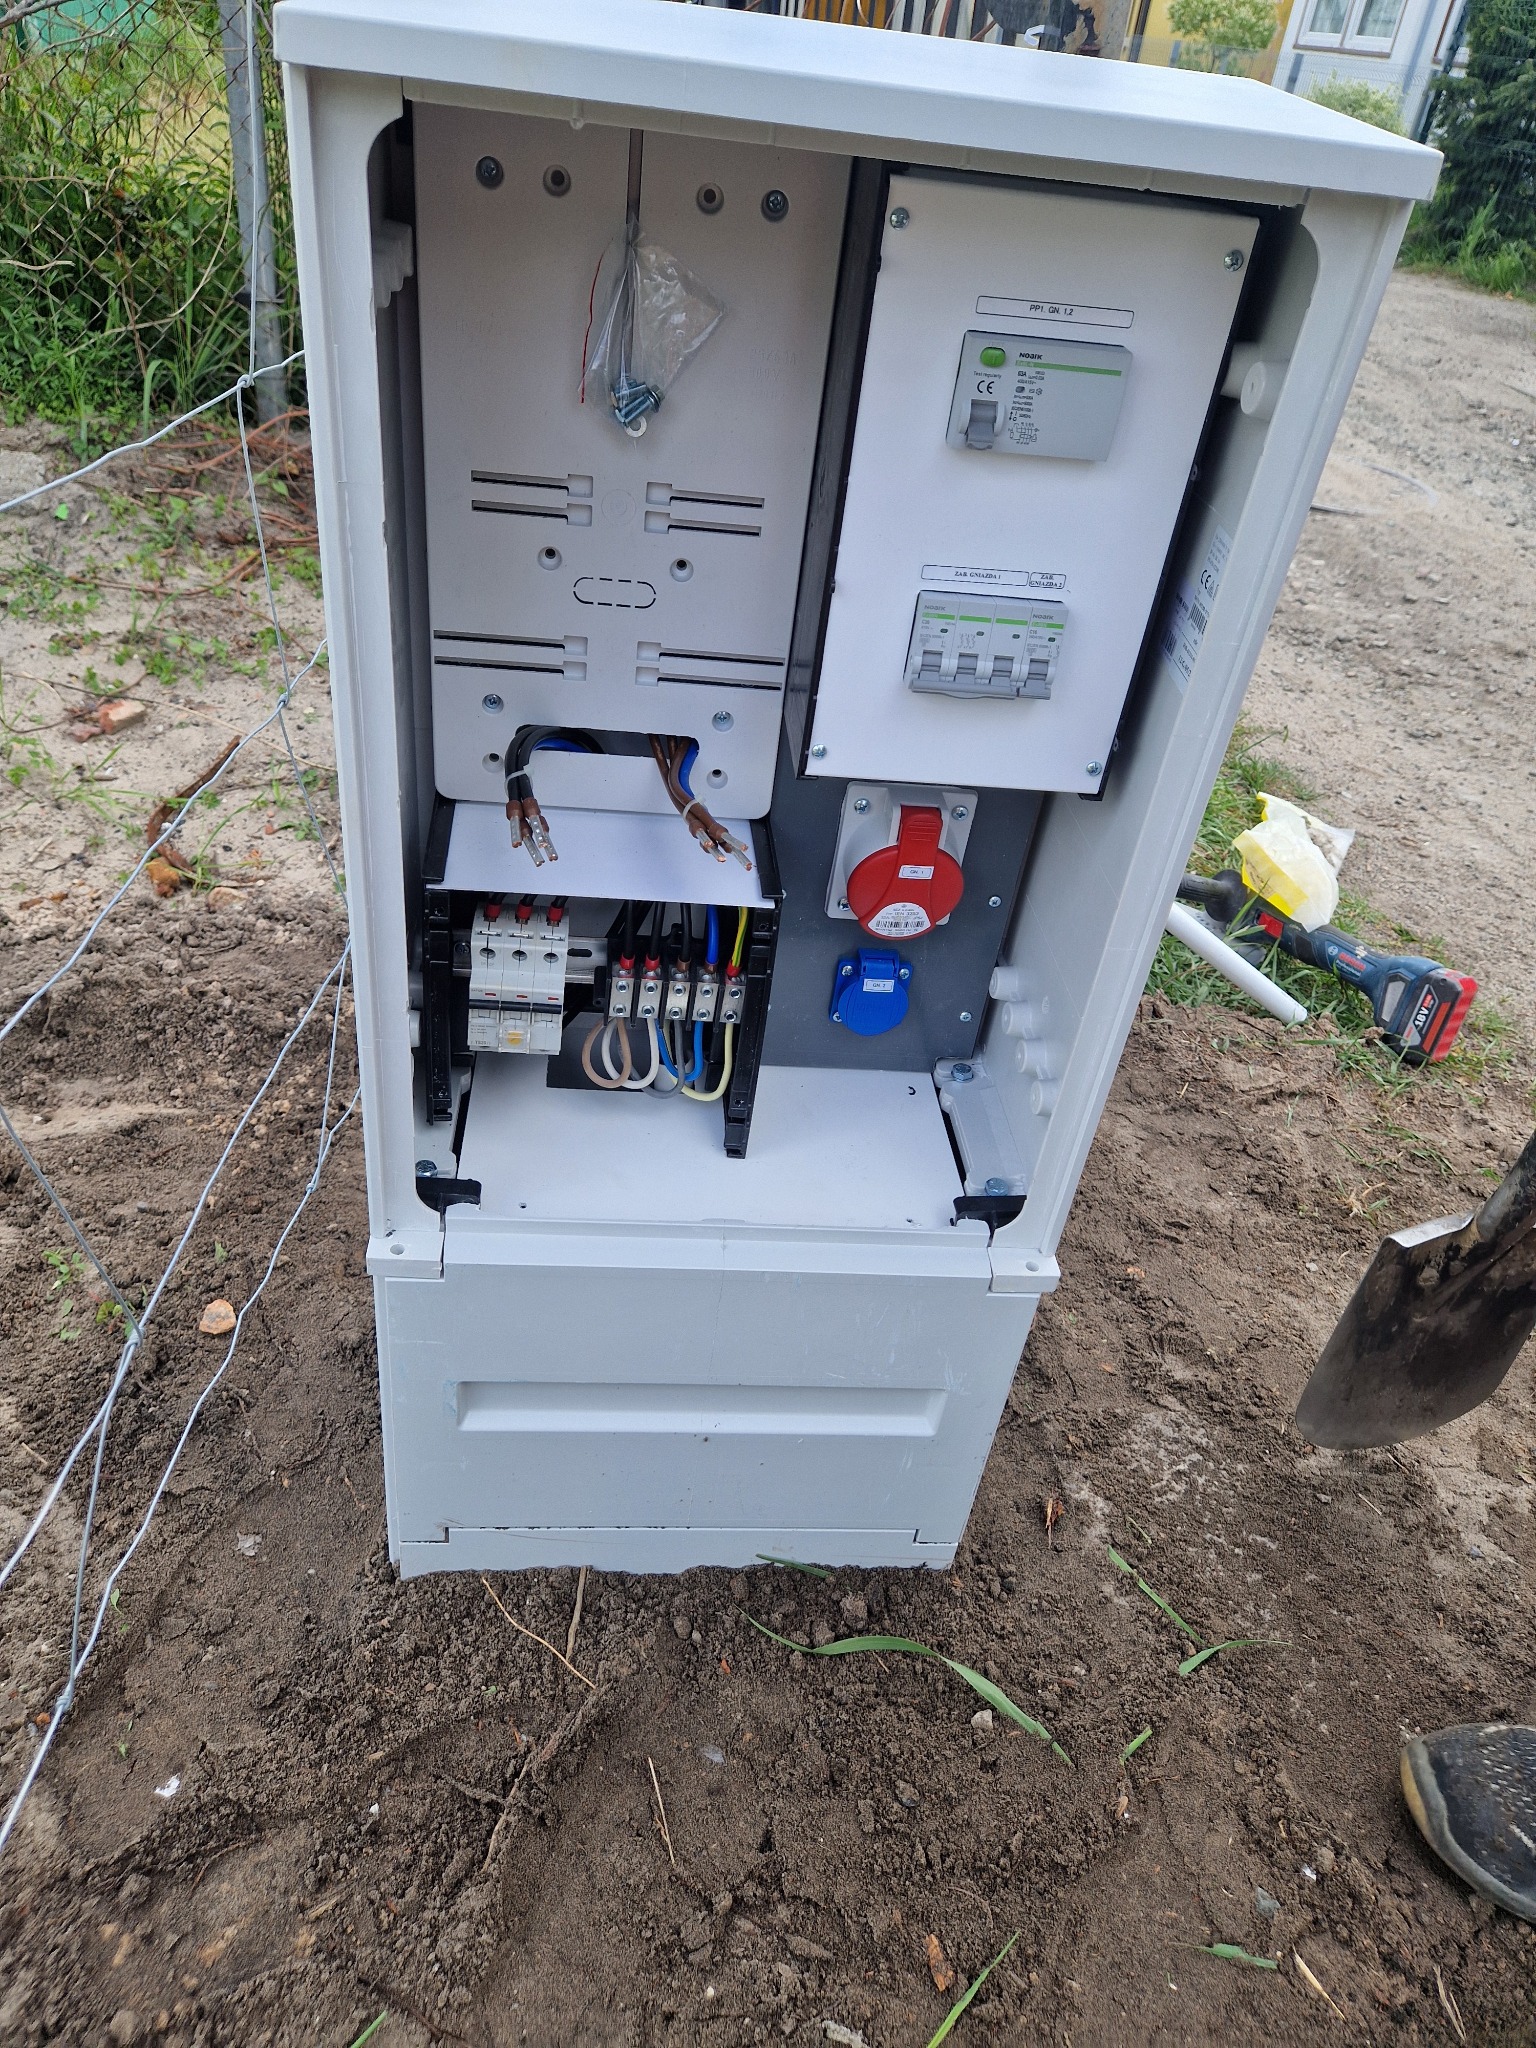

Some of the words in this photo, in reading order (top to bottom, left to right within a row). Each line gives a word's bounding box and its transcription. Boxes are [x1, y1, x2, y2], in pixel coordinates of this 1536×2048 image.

[1030, 304, 1046, 313] PP1.
[1048, 306, 1061, 314] GN.
[1064, 308, 1074, 316] 1,2
[1414, 1006, 1429, 1028] 18V
